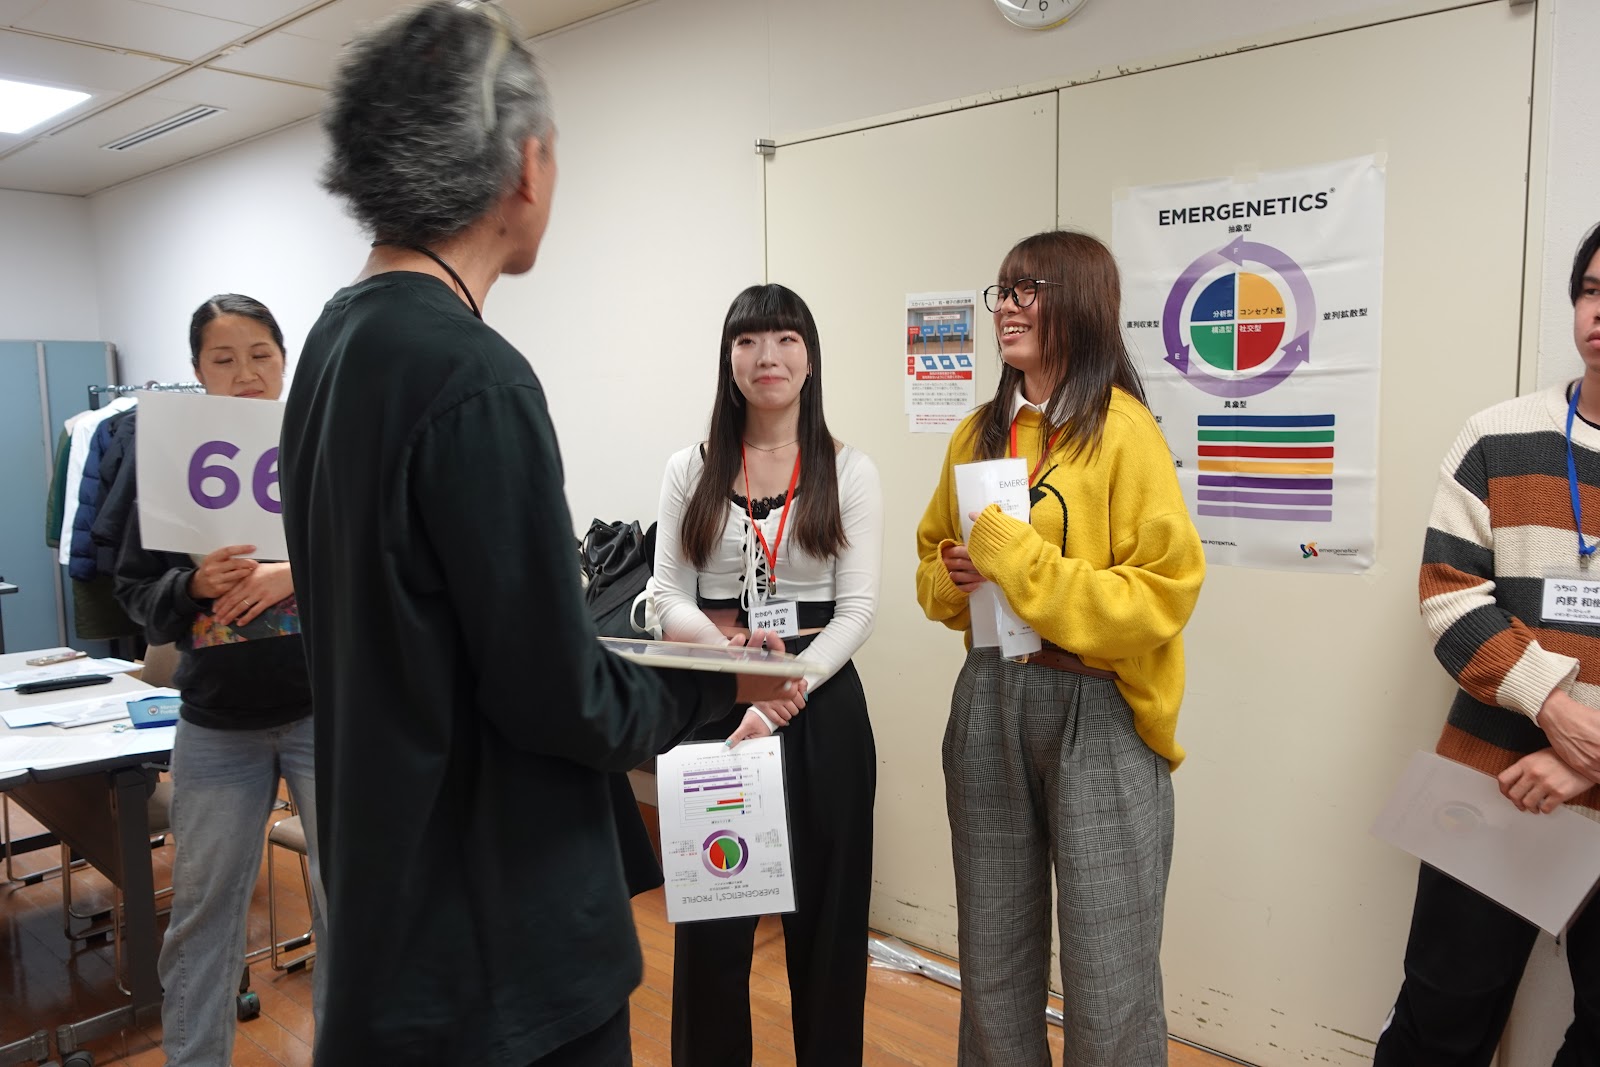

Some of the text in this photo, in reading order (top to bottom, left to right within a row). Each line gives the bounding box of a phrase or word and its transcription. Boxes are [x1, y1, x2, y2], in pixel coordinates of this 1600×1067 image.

[1039, 0, 1048, 11] 6
[1228, 223, 1252, 234] 抽象型
[1212, 306, 1283, 318] 分析型 コンセプト型
[1322, 307, 1368, 321] 並列拡散型
[1126, 320, 1160, 329] 直列収束型
[1211, 324, 1262, 334] 構造型 社交型
[1223, 400, 1248, 409] 具象型
[1554, 584, 1578, 592] うちの
[1555, 596, 1578, 606] 内野
[758, 620, 771, 628] 高村
